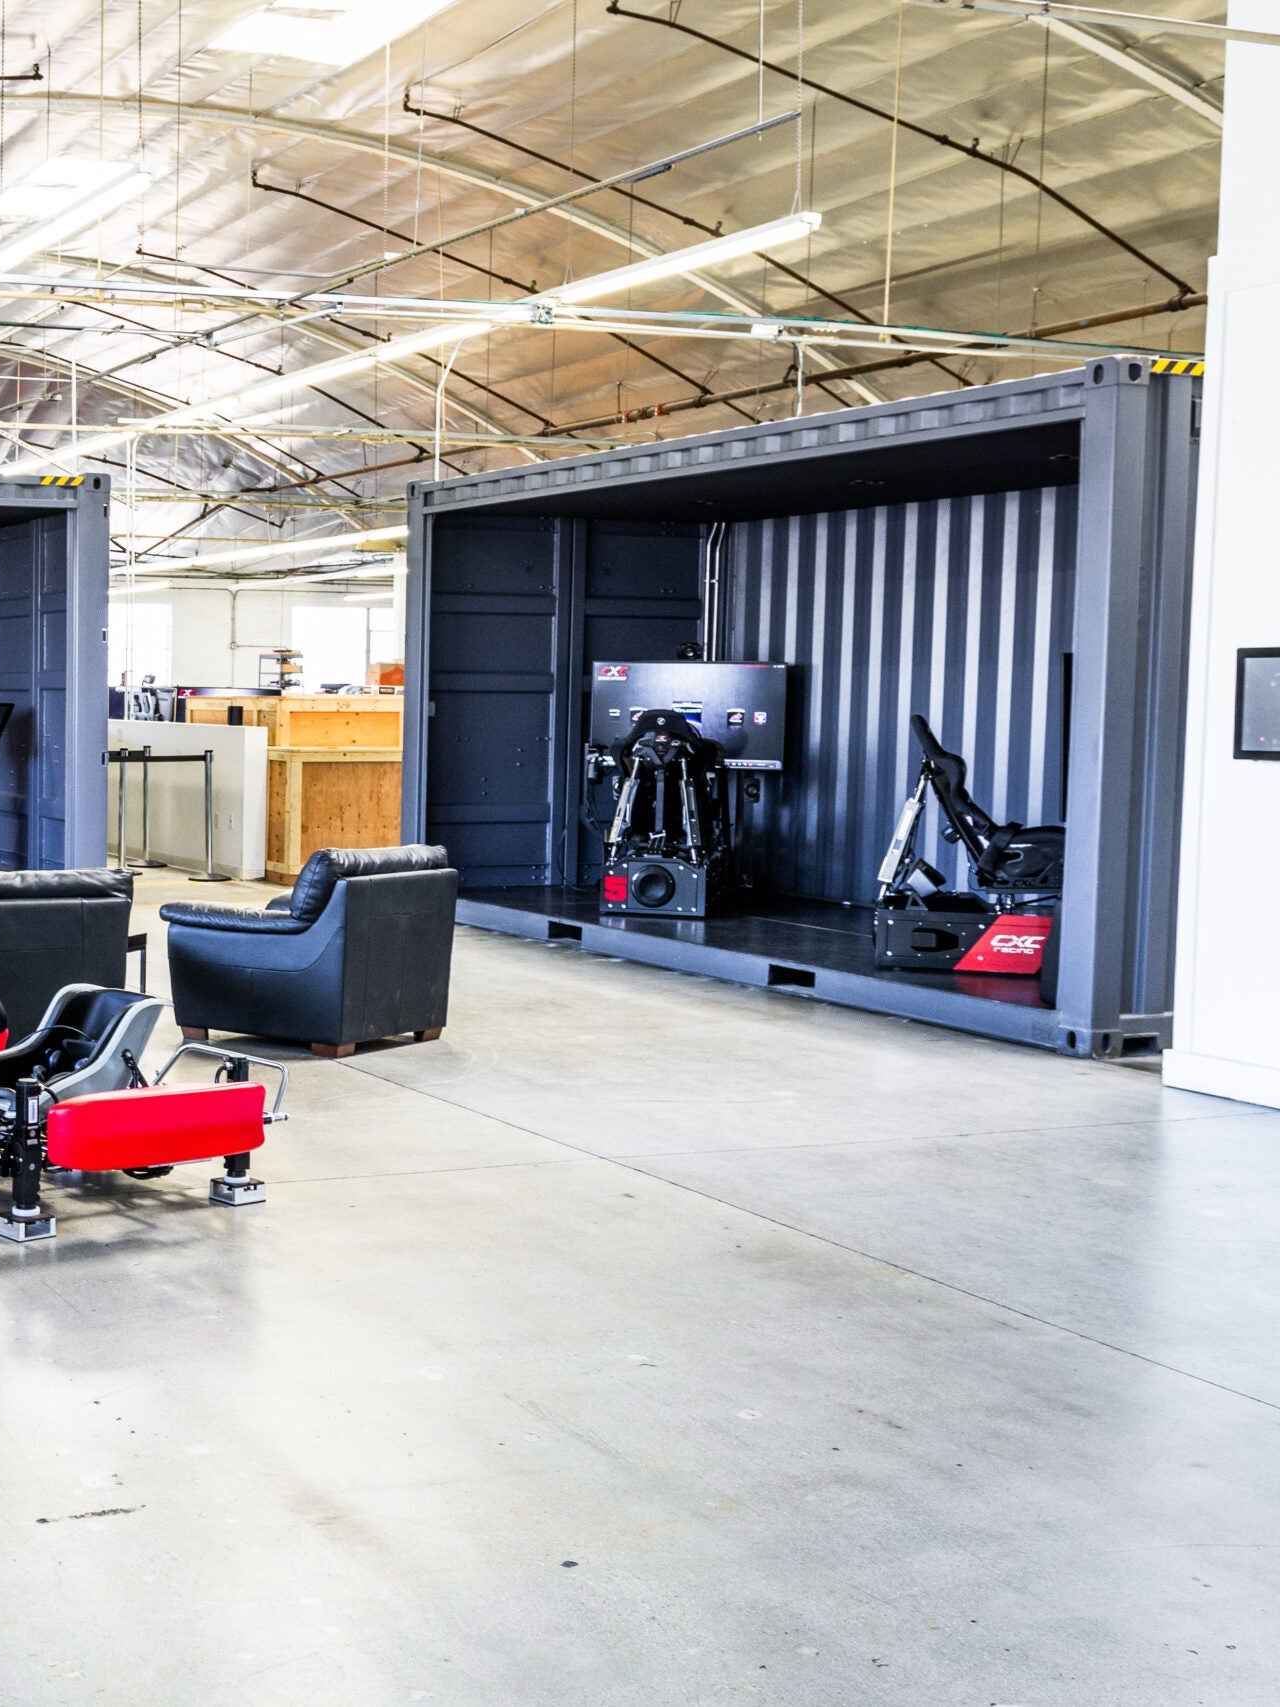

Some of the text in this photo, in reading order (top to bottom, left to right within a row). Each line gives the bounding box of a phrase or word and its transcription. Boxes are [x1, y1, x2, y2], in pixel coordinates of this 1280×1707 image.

[600, 665, 630, 677] CXC
[604, 876, 627, 902] 5
[990, 934, 1046, 948] CXC
